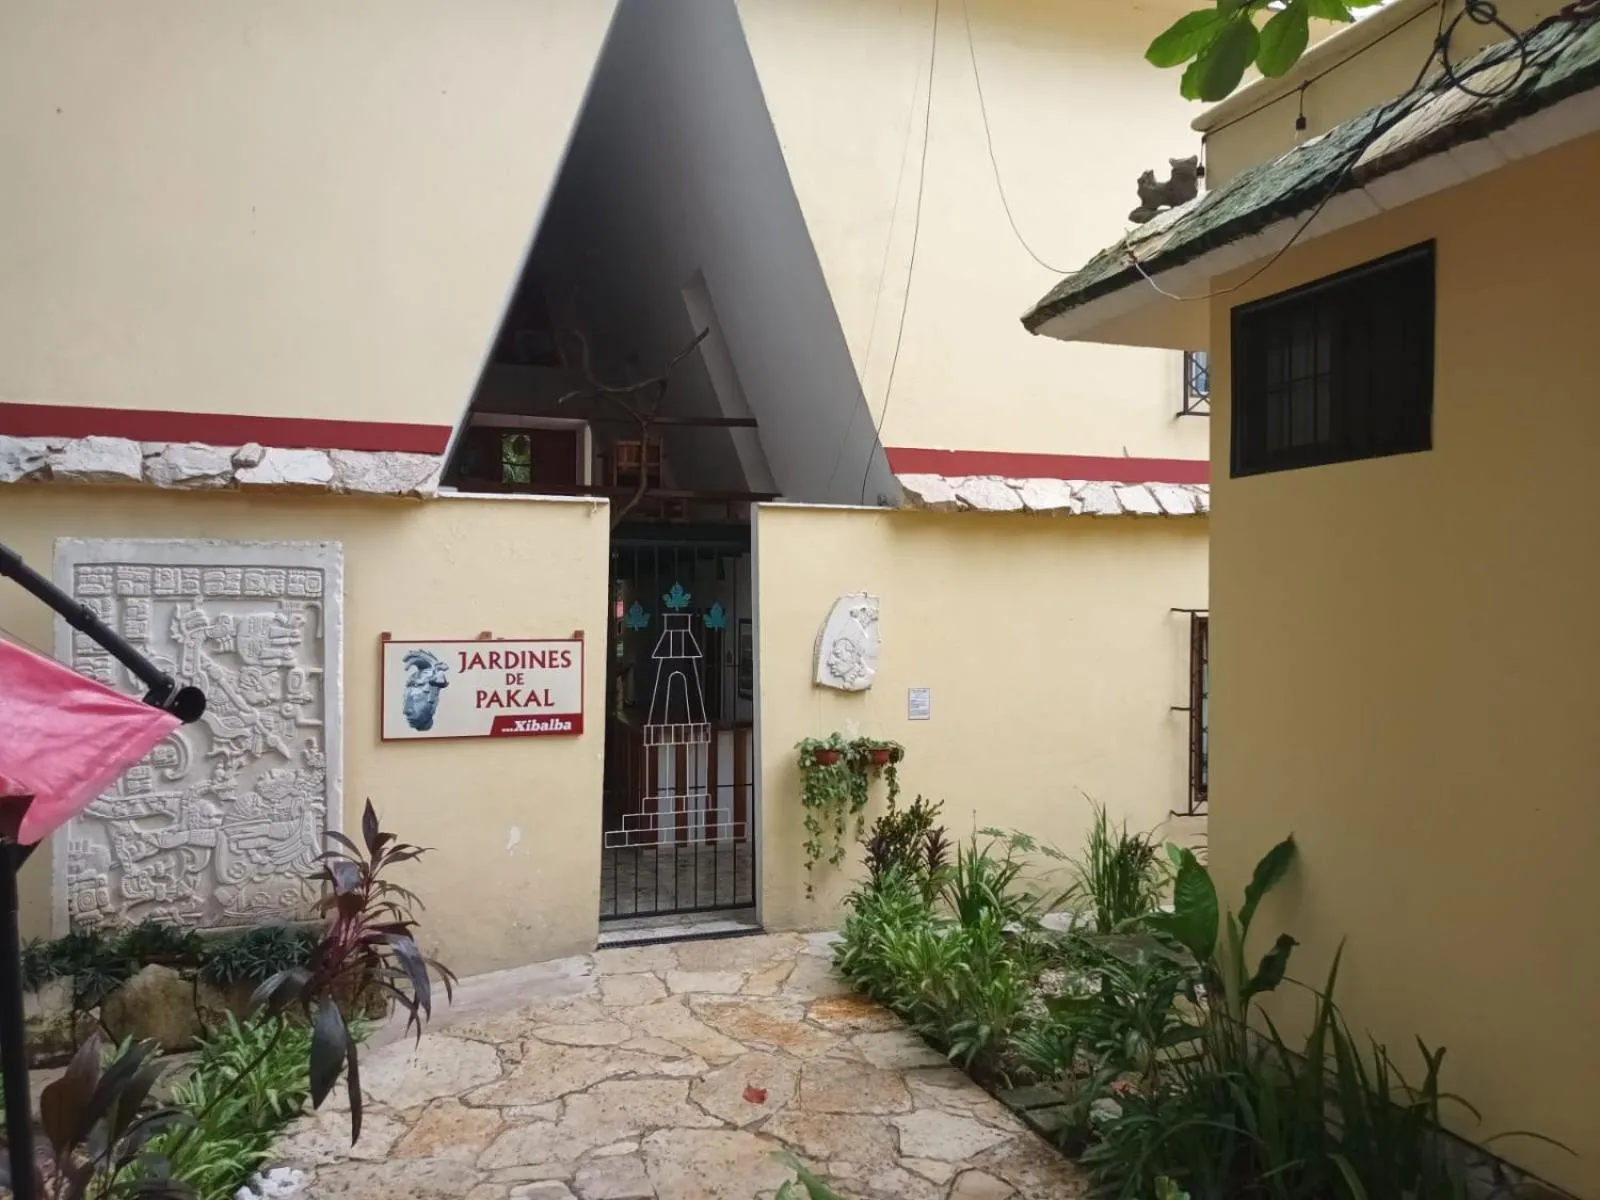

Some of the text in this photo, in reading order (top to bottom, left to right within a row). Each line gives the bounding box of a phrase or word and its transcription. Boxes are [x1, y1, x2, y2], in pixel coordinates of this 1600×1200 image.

[458, 650, 571, 673] JARDINES
[505, 673, 525, 686] DE
[475, 688, 555, 709] PAKAL
